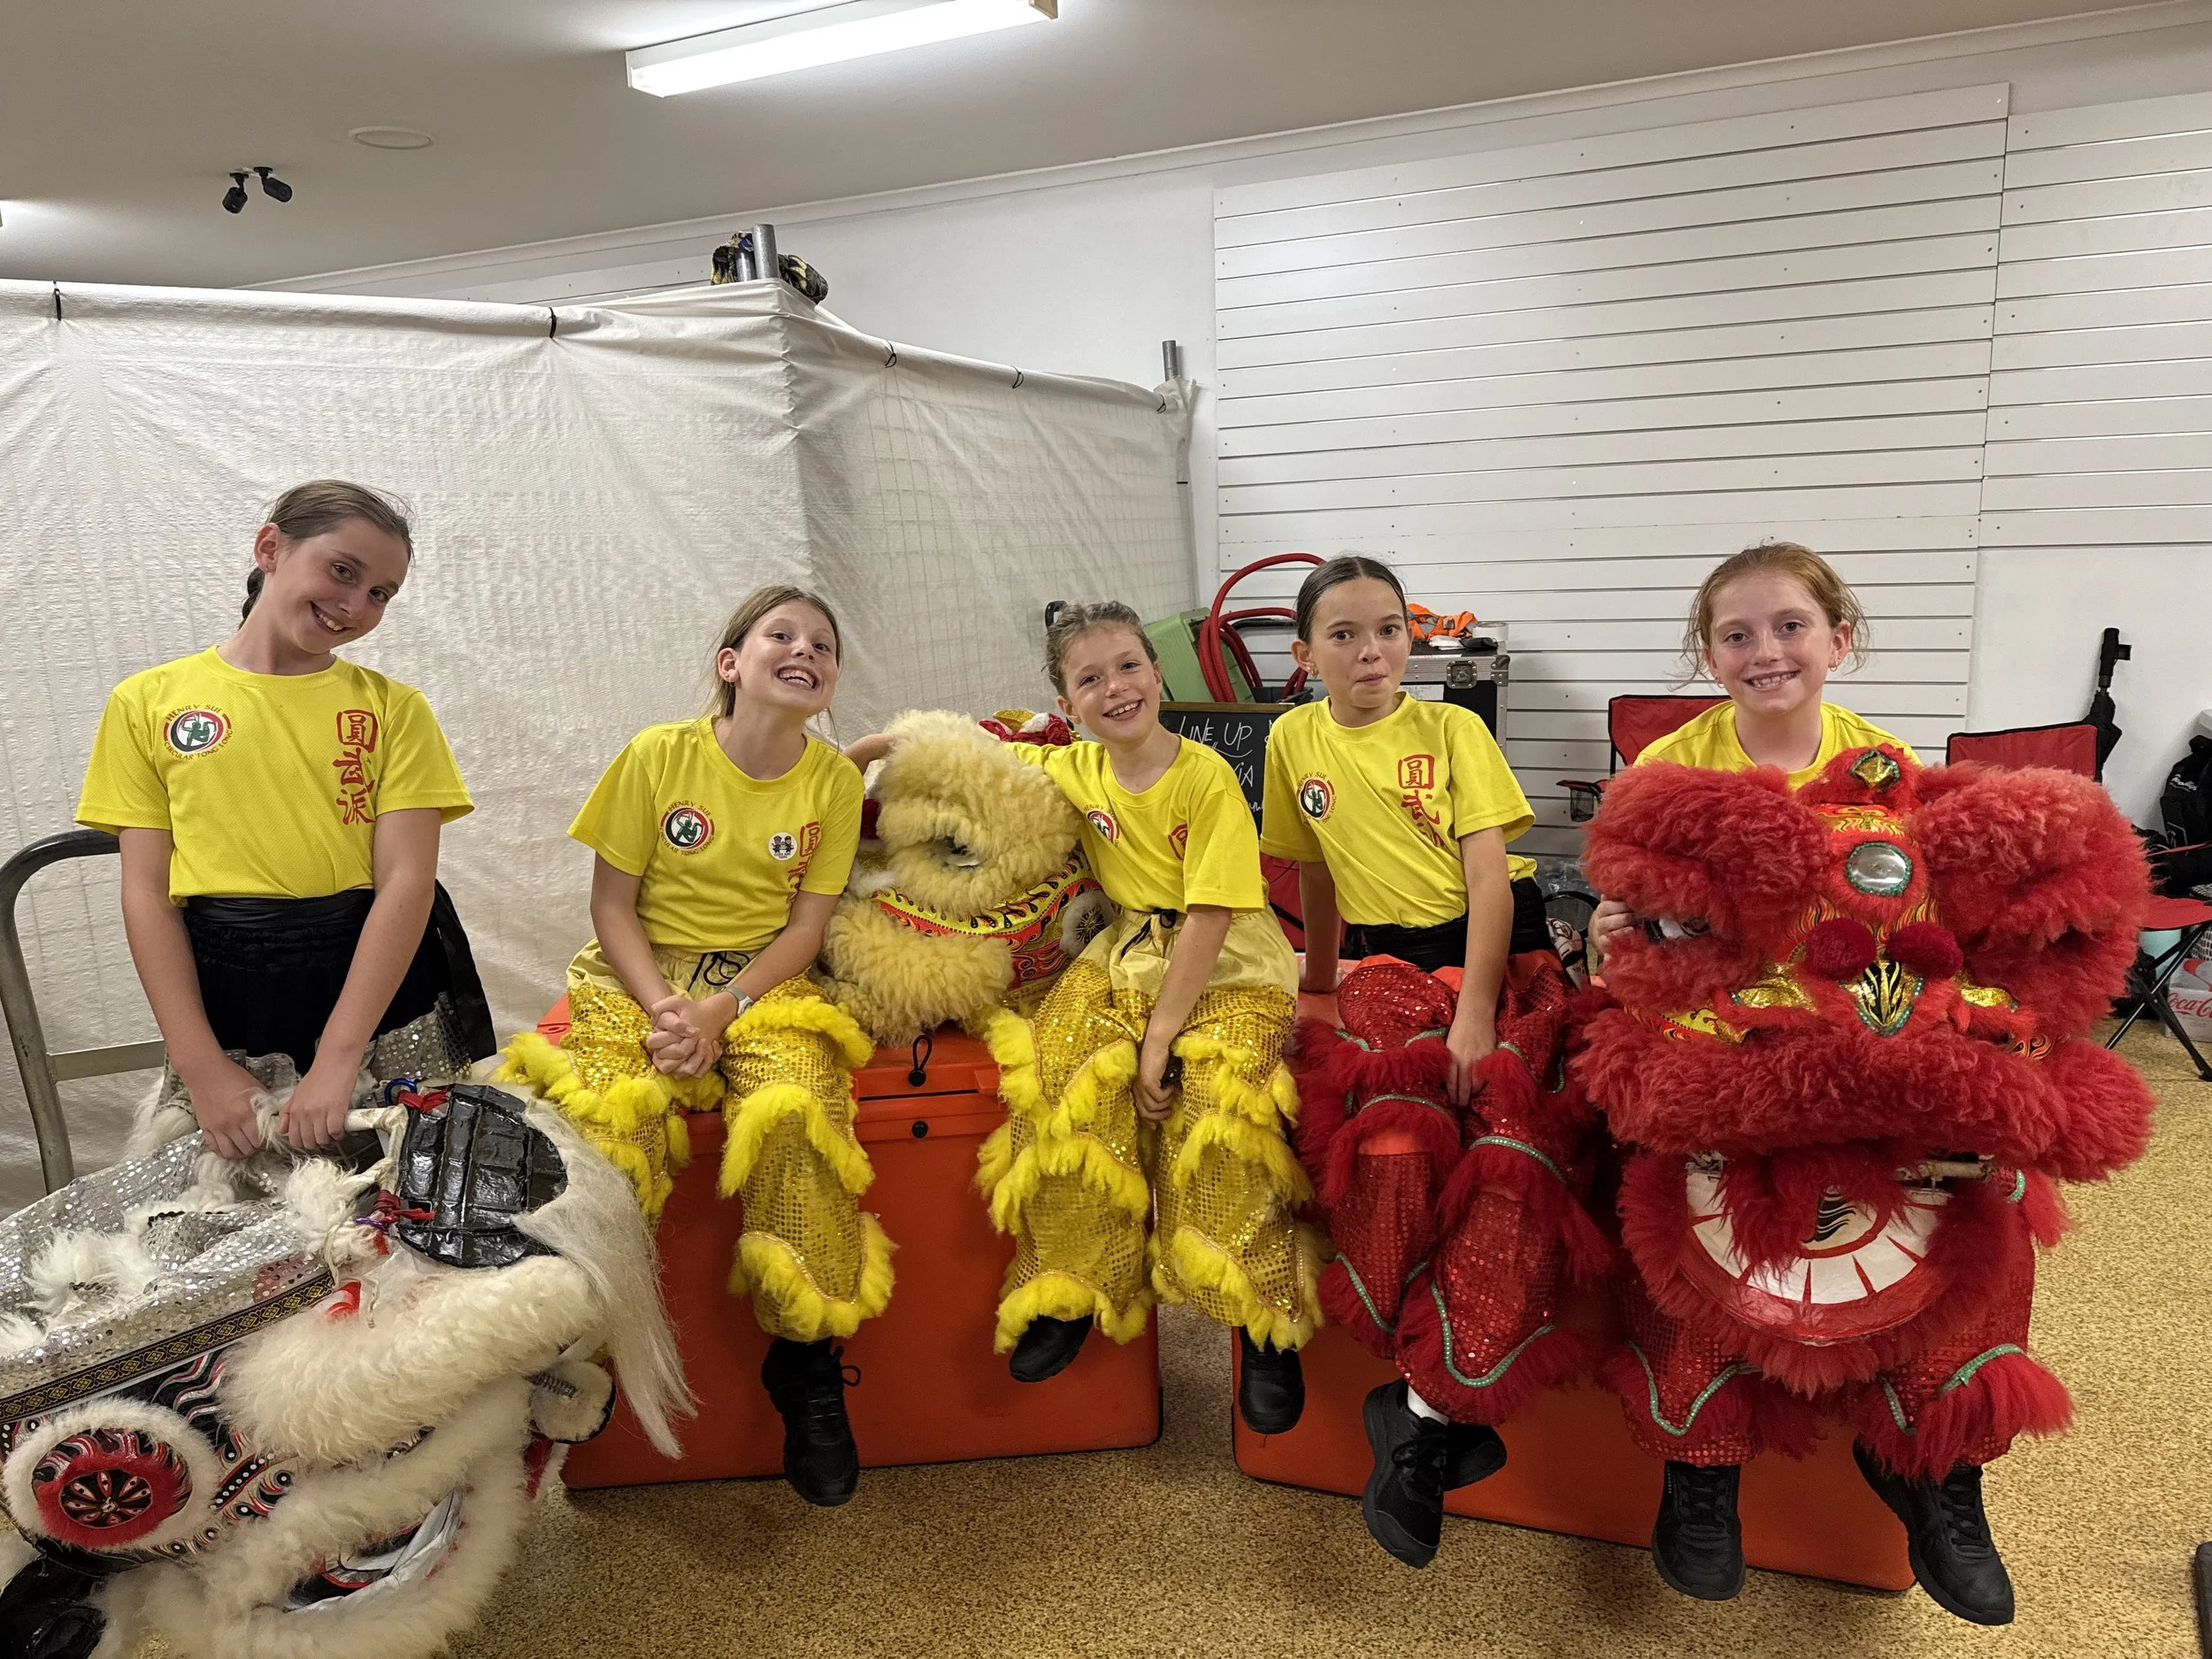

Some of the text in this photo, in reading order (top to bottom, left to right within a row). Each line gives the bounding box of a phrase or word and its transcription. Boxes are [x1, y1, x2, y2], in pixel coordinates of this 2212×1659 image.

[165, 703, 200, 721] HENRY
[1224, 722, 1253, 751] UP
[196, 747, 219, 758] TONG
[668, 800, 696, 811] HENRY
